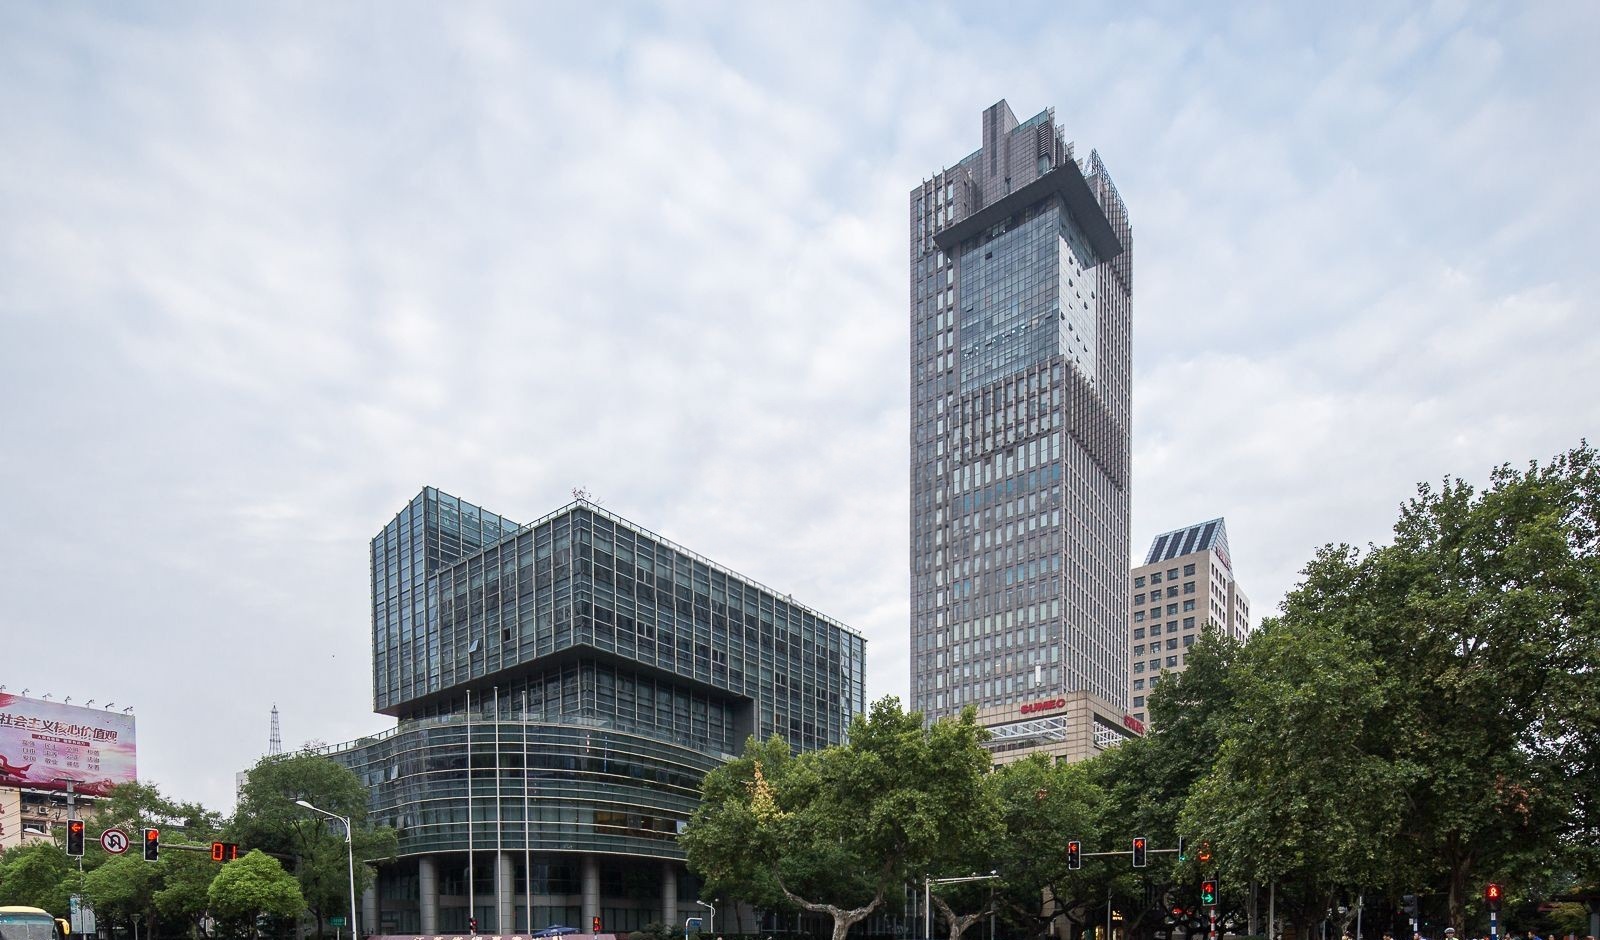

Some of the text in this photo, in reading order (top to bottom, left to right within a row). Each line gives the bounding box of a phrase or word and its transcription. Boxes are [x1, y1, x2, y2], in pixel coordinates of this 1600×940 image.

[0, 713, 118, 741] 社会主义核心价值观
